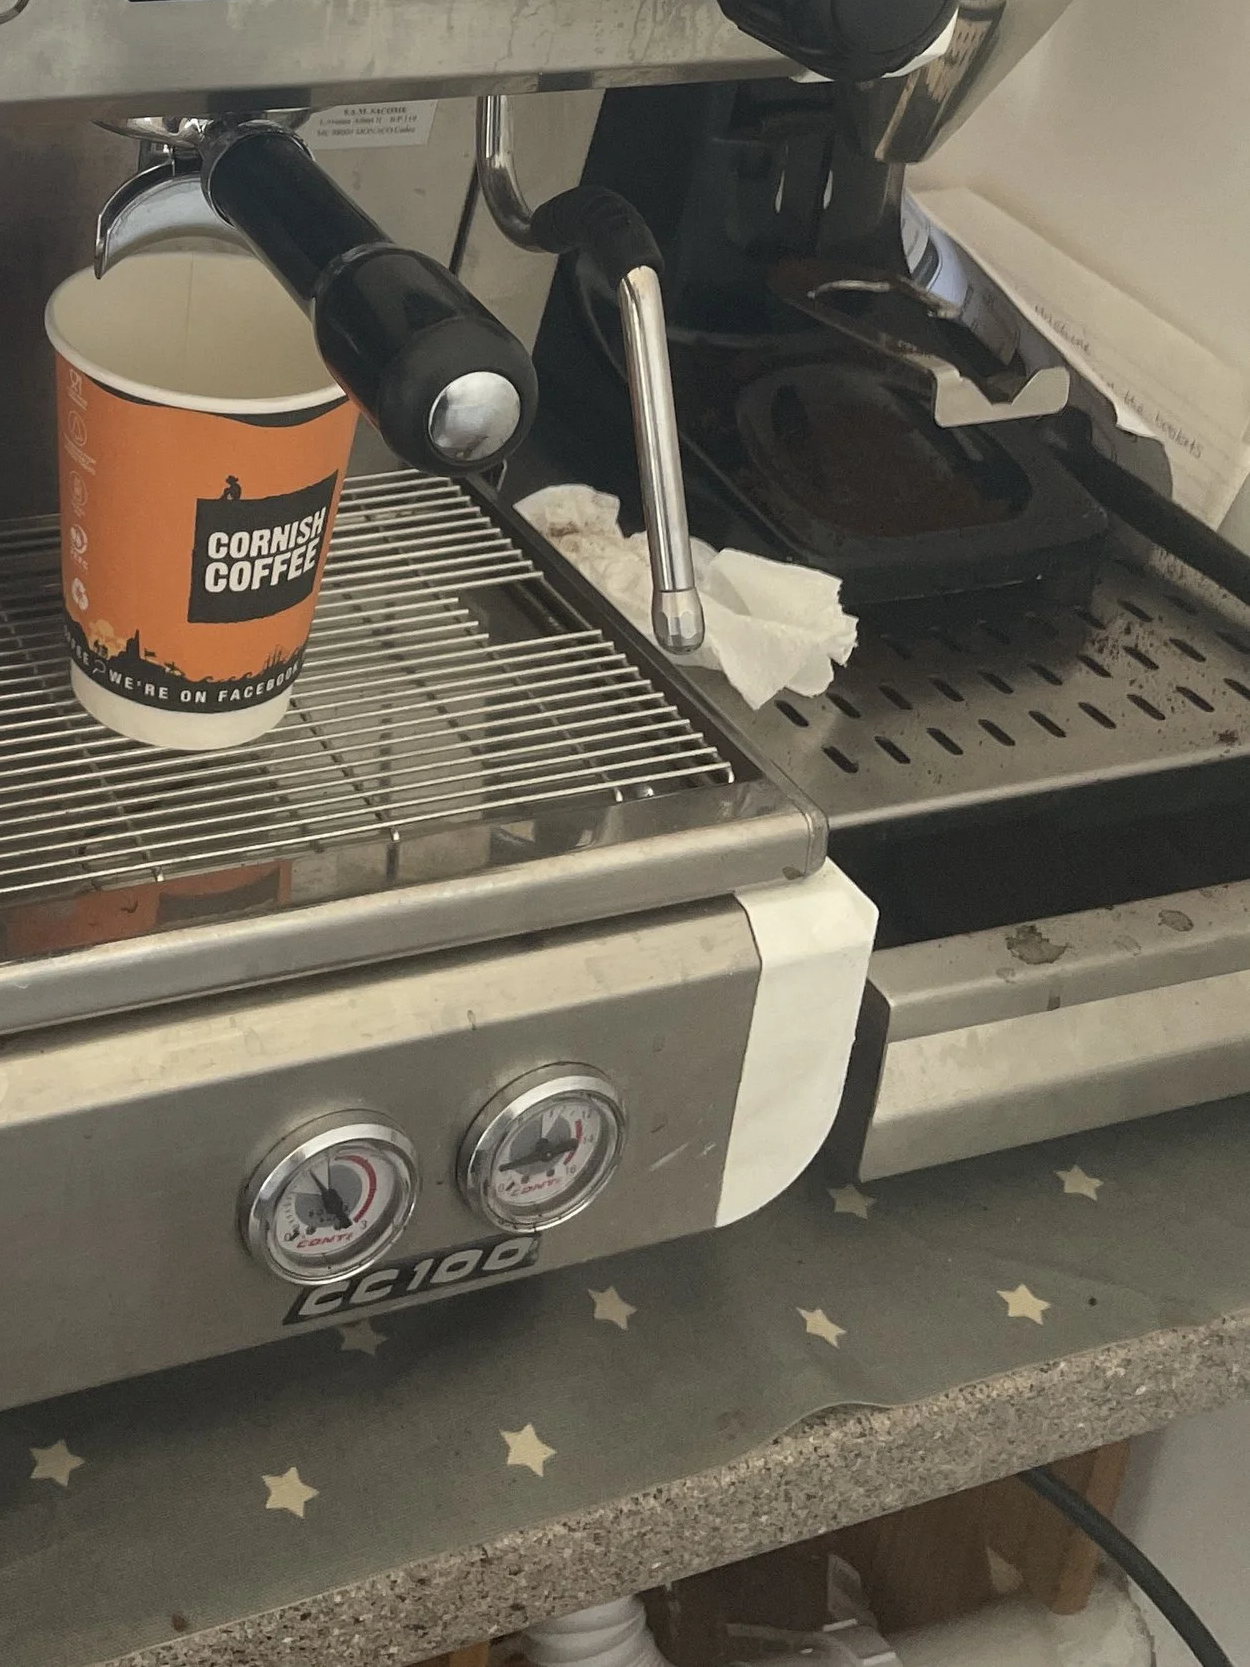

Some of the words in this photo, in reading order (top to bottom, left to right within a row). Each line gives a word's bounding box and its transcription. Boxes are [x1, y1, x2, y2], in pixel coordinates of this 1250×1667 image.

[208, 506, 326, 559] CORNISH
[205, 537, 320, 592] COFFEE
[109, 669, 169, 700] WE'RE
[180, 690, 207, 703] ON
[217, 659, 300, 702] FACEBOOK
[298, 1236, 537, 1316] CC100
